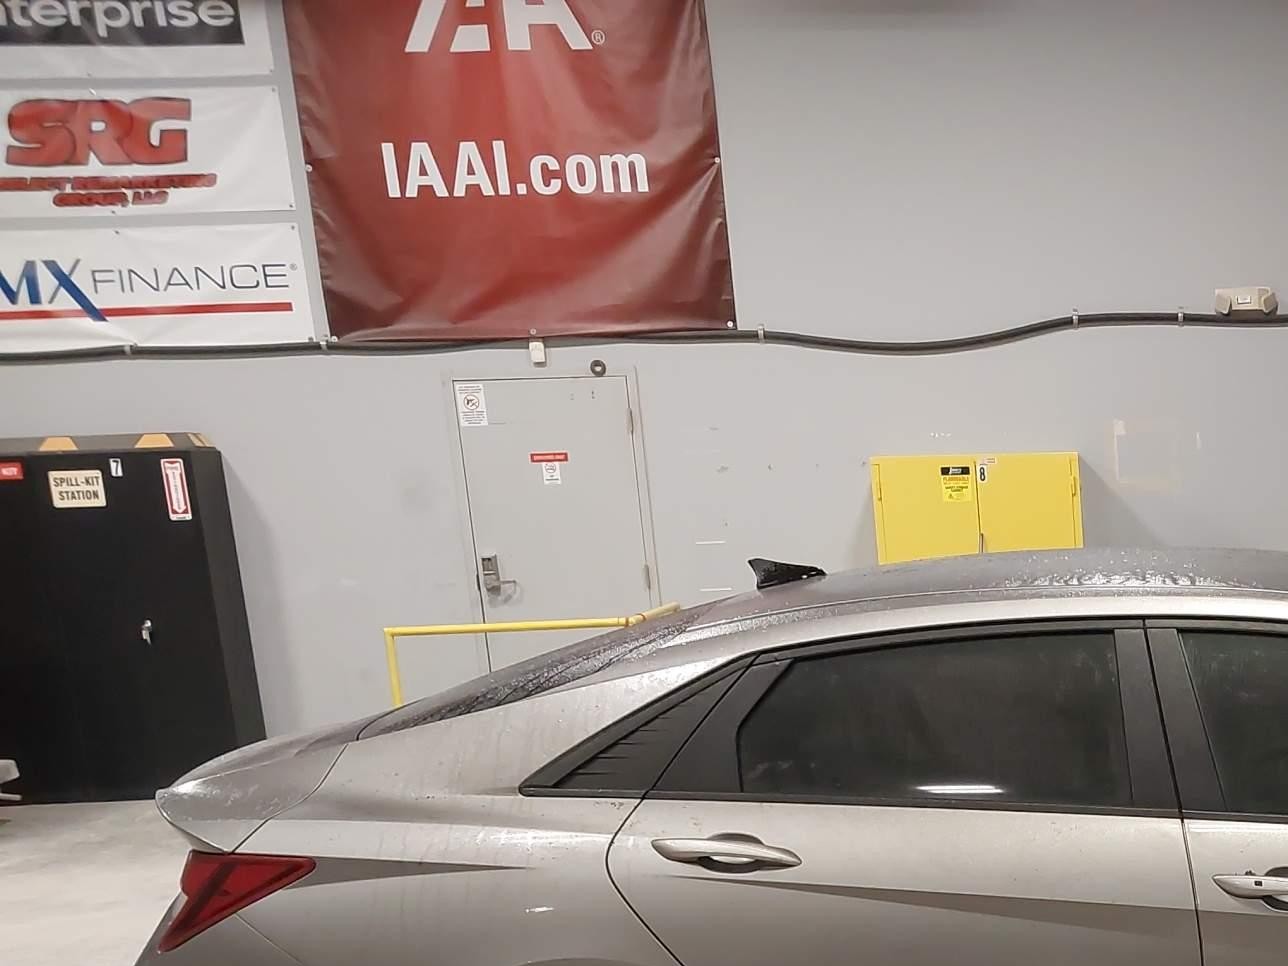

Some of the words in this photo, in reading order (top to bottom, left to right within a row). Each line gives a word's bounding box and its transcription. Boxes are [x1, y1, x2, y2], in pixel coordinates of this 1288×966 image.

[6, 97, 192, 167] SRG
[381, 140, 649, 198] IAAI.com
[91, 263, 290, 295] FINANCE
[112, 459, 120, 475] 7
[980, 466, 986, 481] 8
[53, 476, 100, 488] SPILL-KIT
[58, 490, 100, 502] STATION
